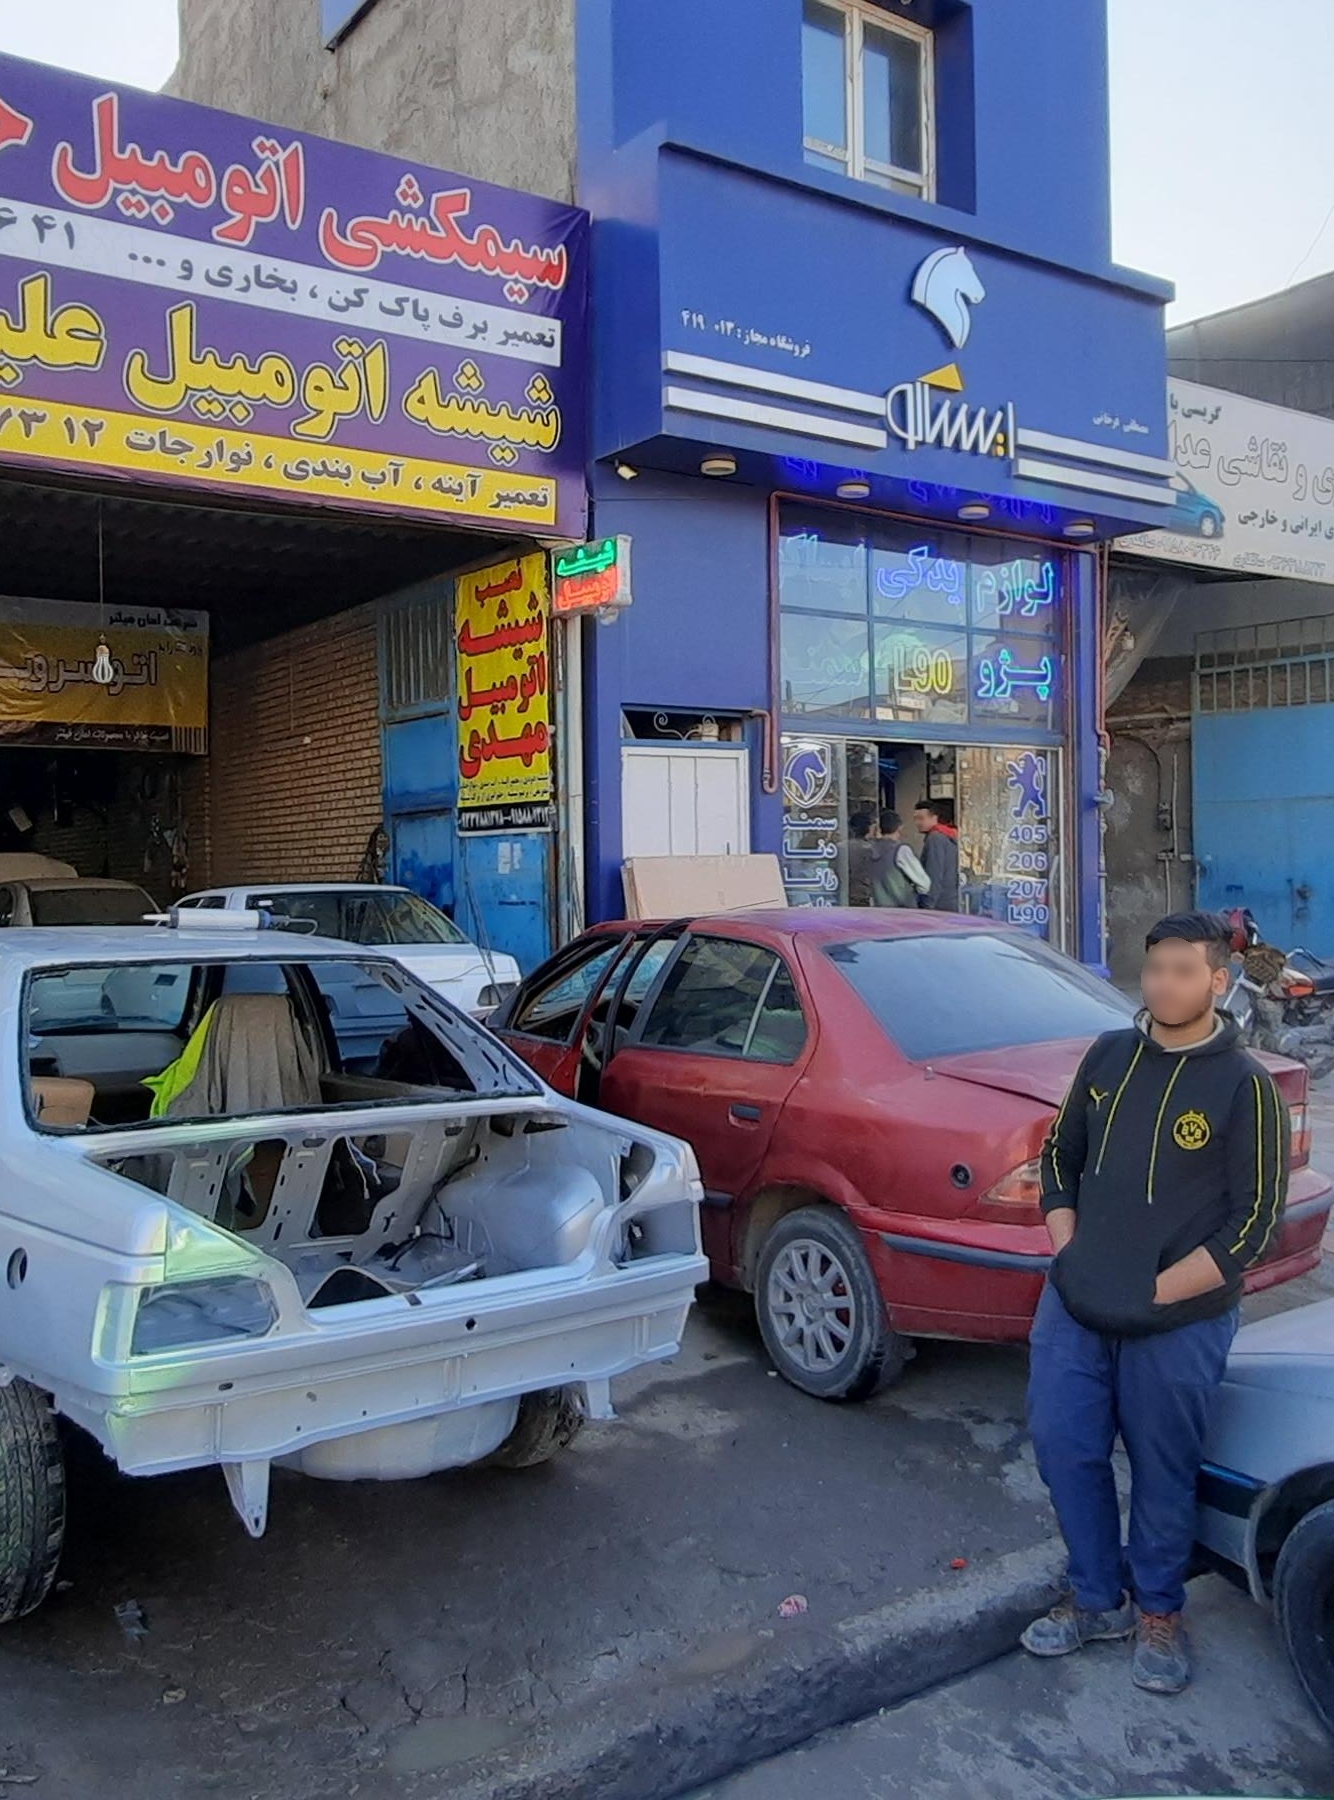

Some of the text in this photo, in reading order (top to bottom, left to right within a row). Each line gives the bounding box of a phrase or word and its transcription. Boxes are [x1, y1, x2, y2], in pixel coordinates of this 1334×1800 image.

[52, 92, 305, 245] اتومبیل
[32, 213, 76, 250] ۴۱
[319, 174, 567, 303] سیمکشی
[177, 258, 194, 280] و
[204, 262, 299, 297] بخاری
[327, 287, 369, 312] کن
[378, 297, 430, 331] پاک
[437, 301, 489, 339] برف
[496, 324, 556, 349] تعمیر
[769, 334, 812, 359] فروشگاه
[124, 300, 387, 443] اتومبیل
[404, 359, 562, 466] شیشه
[62, 415, 105, 448] ۱۲
[282, 457, 353, 488] بندی
[360, 460, 405, 490] آب
[1217, 436, 1289, 486] نقاشی
[430, 471, 483, 500] آینه
[488, 484, 552, 510] تعمیر
[1292, 464, 1308, 501] و
[1237, 509, 1278, 531] خارجی
[1280, 521, 1287, 533] و
[1290, 518, 1323, 541] ایرانی
[557, 540, 616, 577] شیشه
[876, 545, 960, 604] یدکی
[475, 559, 523, 607] نصب
[976, 559, 1054, 616] لوازم
[457, 592, 544, 660] شیشه
[458, 651, 546, 721] اتومبیل
[894, 645, 953, 694] L90
[977, 649, 1052, 699] پژو
[459, 719, 549, 778] مهدی
[783, 811, 838, 832] سمند
[1007, 825, 1047, 845] 405
[1006, 852, 1047, 872] 206
[1007, 879, 1047, 898] 207
[1008, 904, 1049, 924] L90
